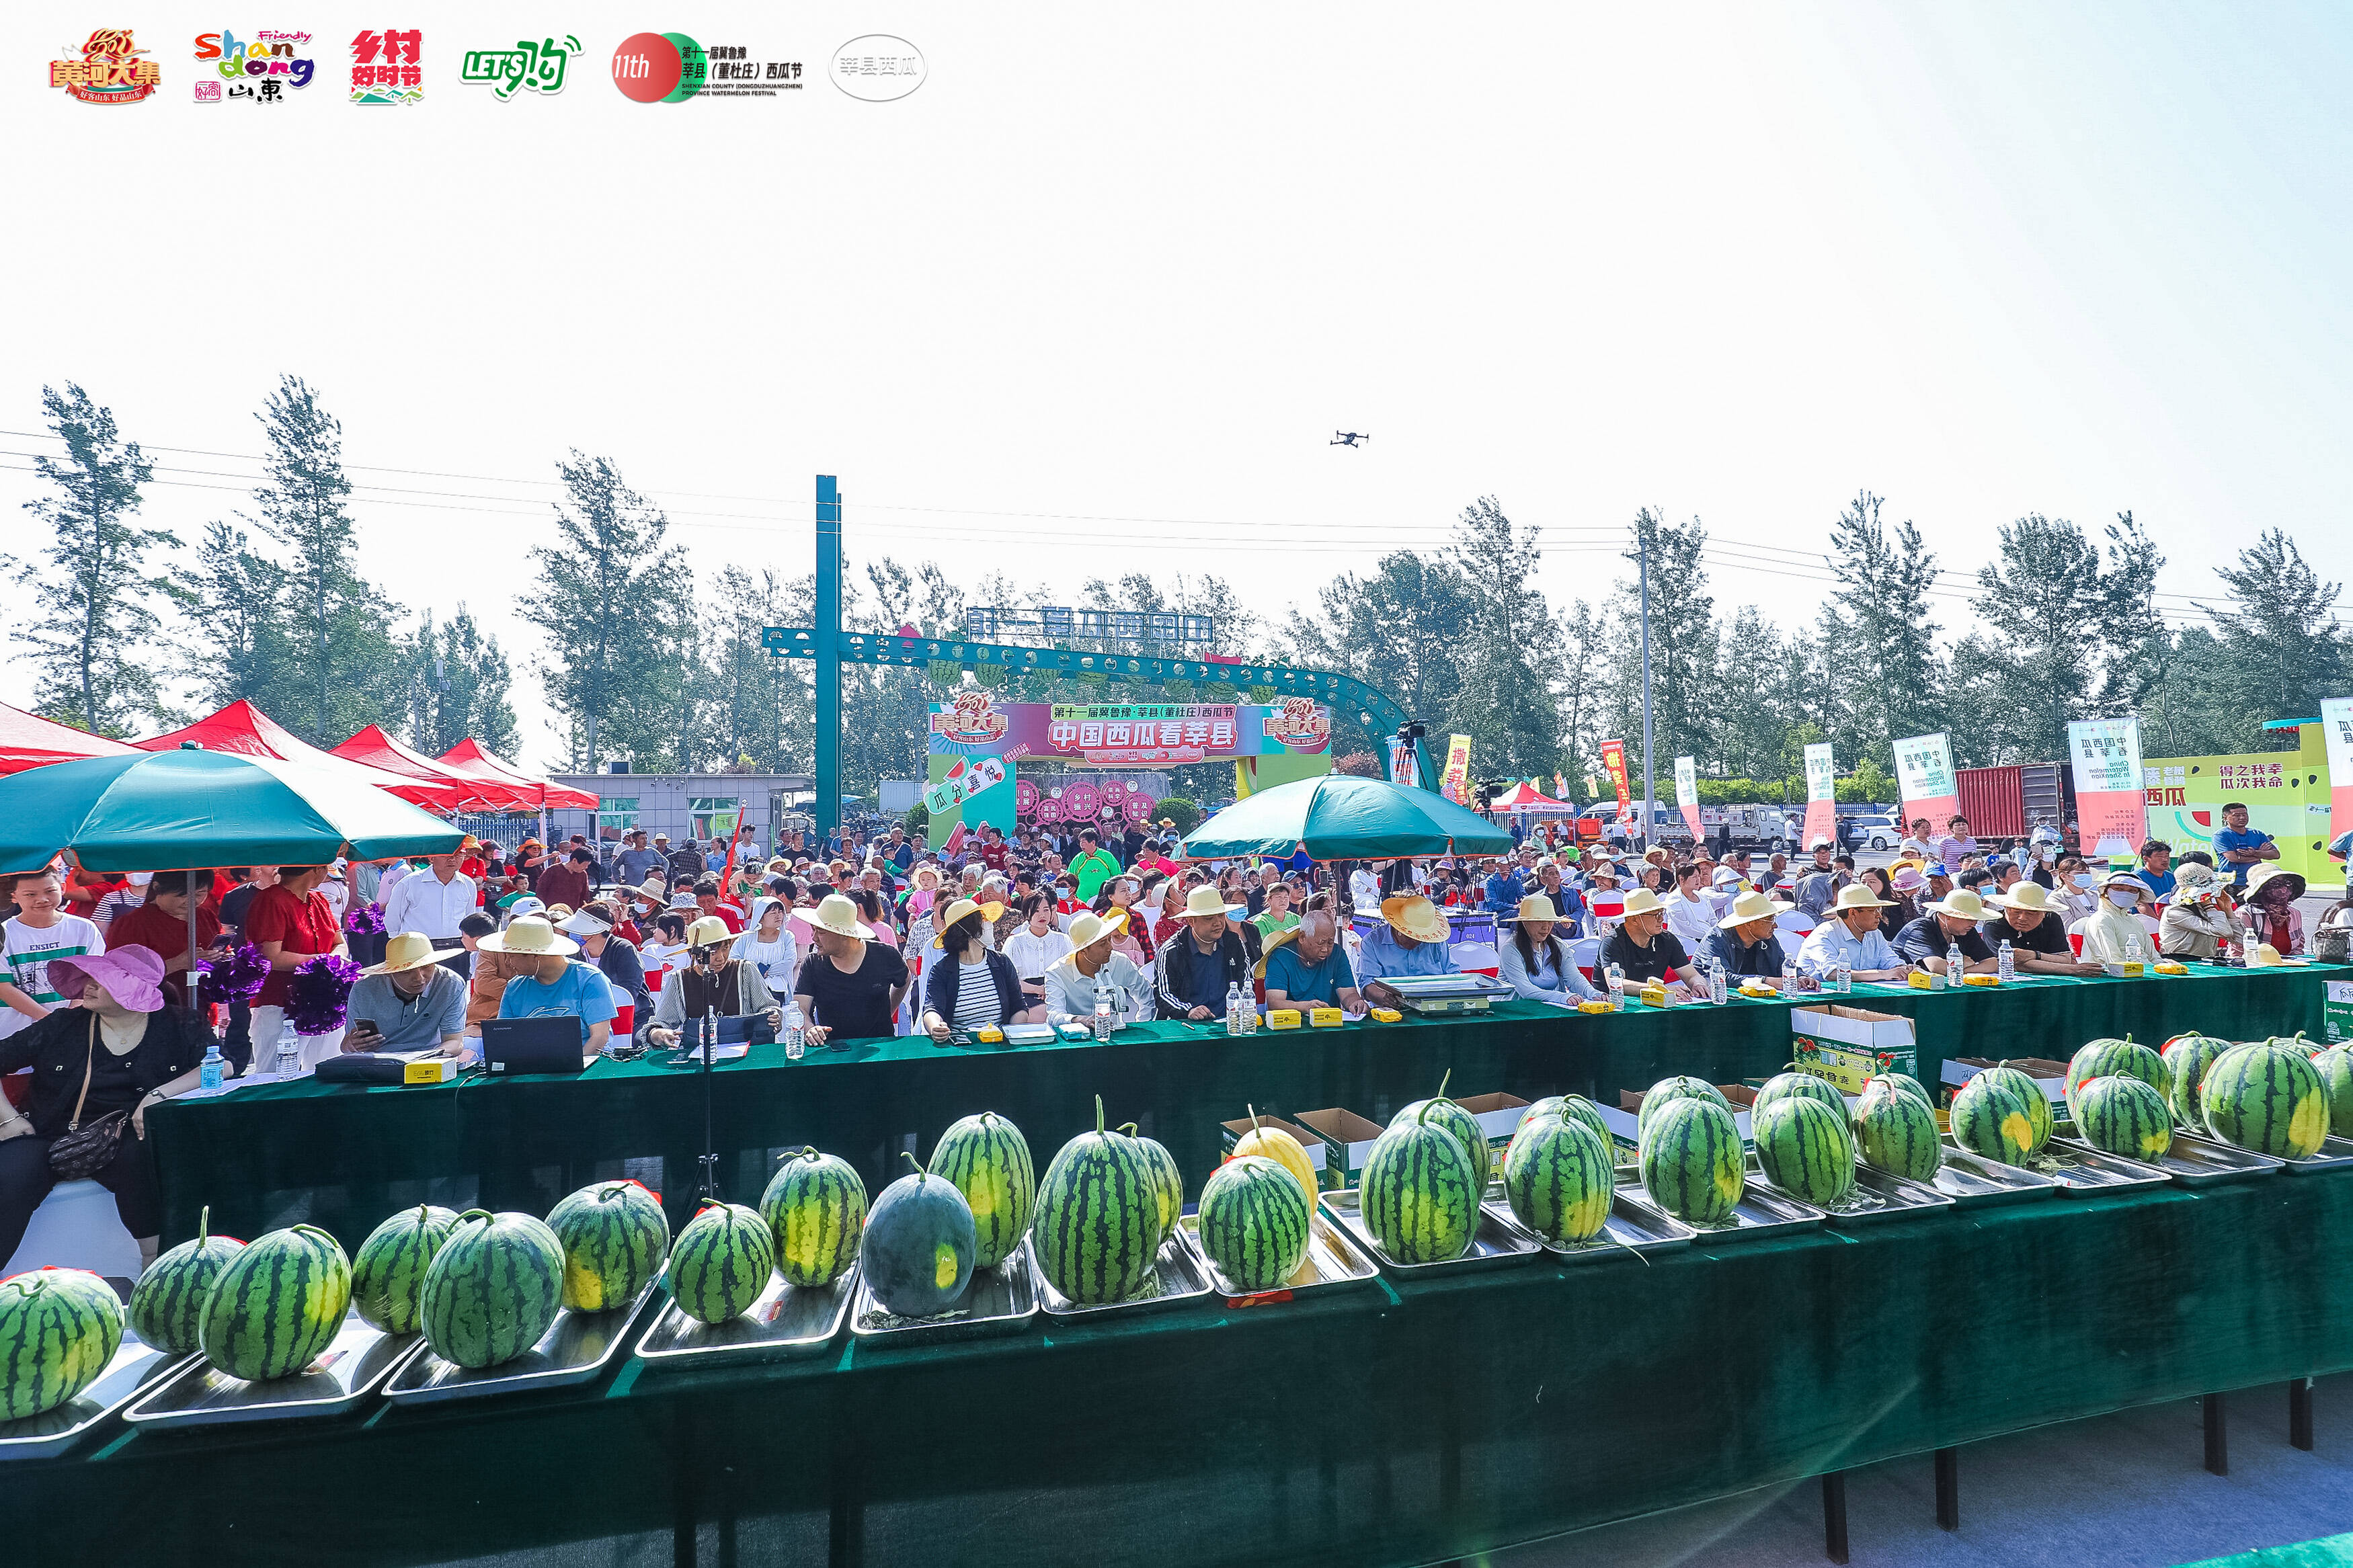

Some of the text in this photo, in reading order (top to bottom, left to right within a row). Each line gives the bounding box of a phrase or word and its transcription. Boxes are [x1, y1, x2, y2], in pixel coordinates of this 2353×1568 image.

[932, 713, 1008, 733] 黄河大集
[1265, 718, 1330, 736] 黄河大集
[1053, 720, 1234, 747] 中国西瓜看莘县
[2219, 763, 2283, 776] 得之我幸
[934, 764, 997, 810] 瓜分喜悦
[2220, 776, 2283, 790] 瓜次我命
[1074, 793, 1092, 801] 乡村
[2142, 787, 2187, 807] 西瓜
[1131, 802, 1149, 810] 普及
[29, 941, 60, 951] ENSICT
